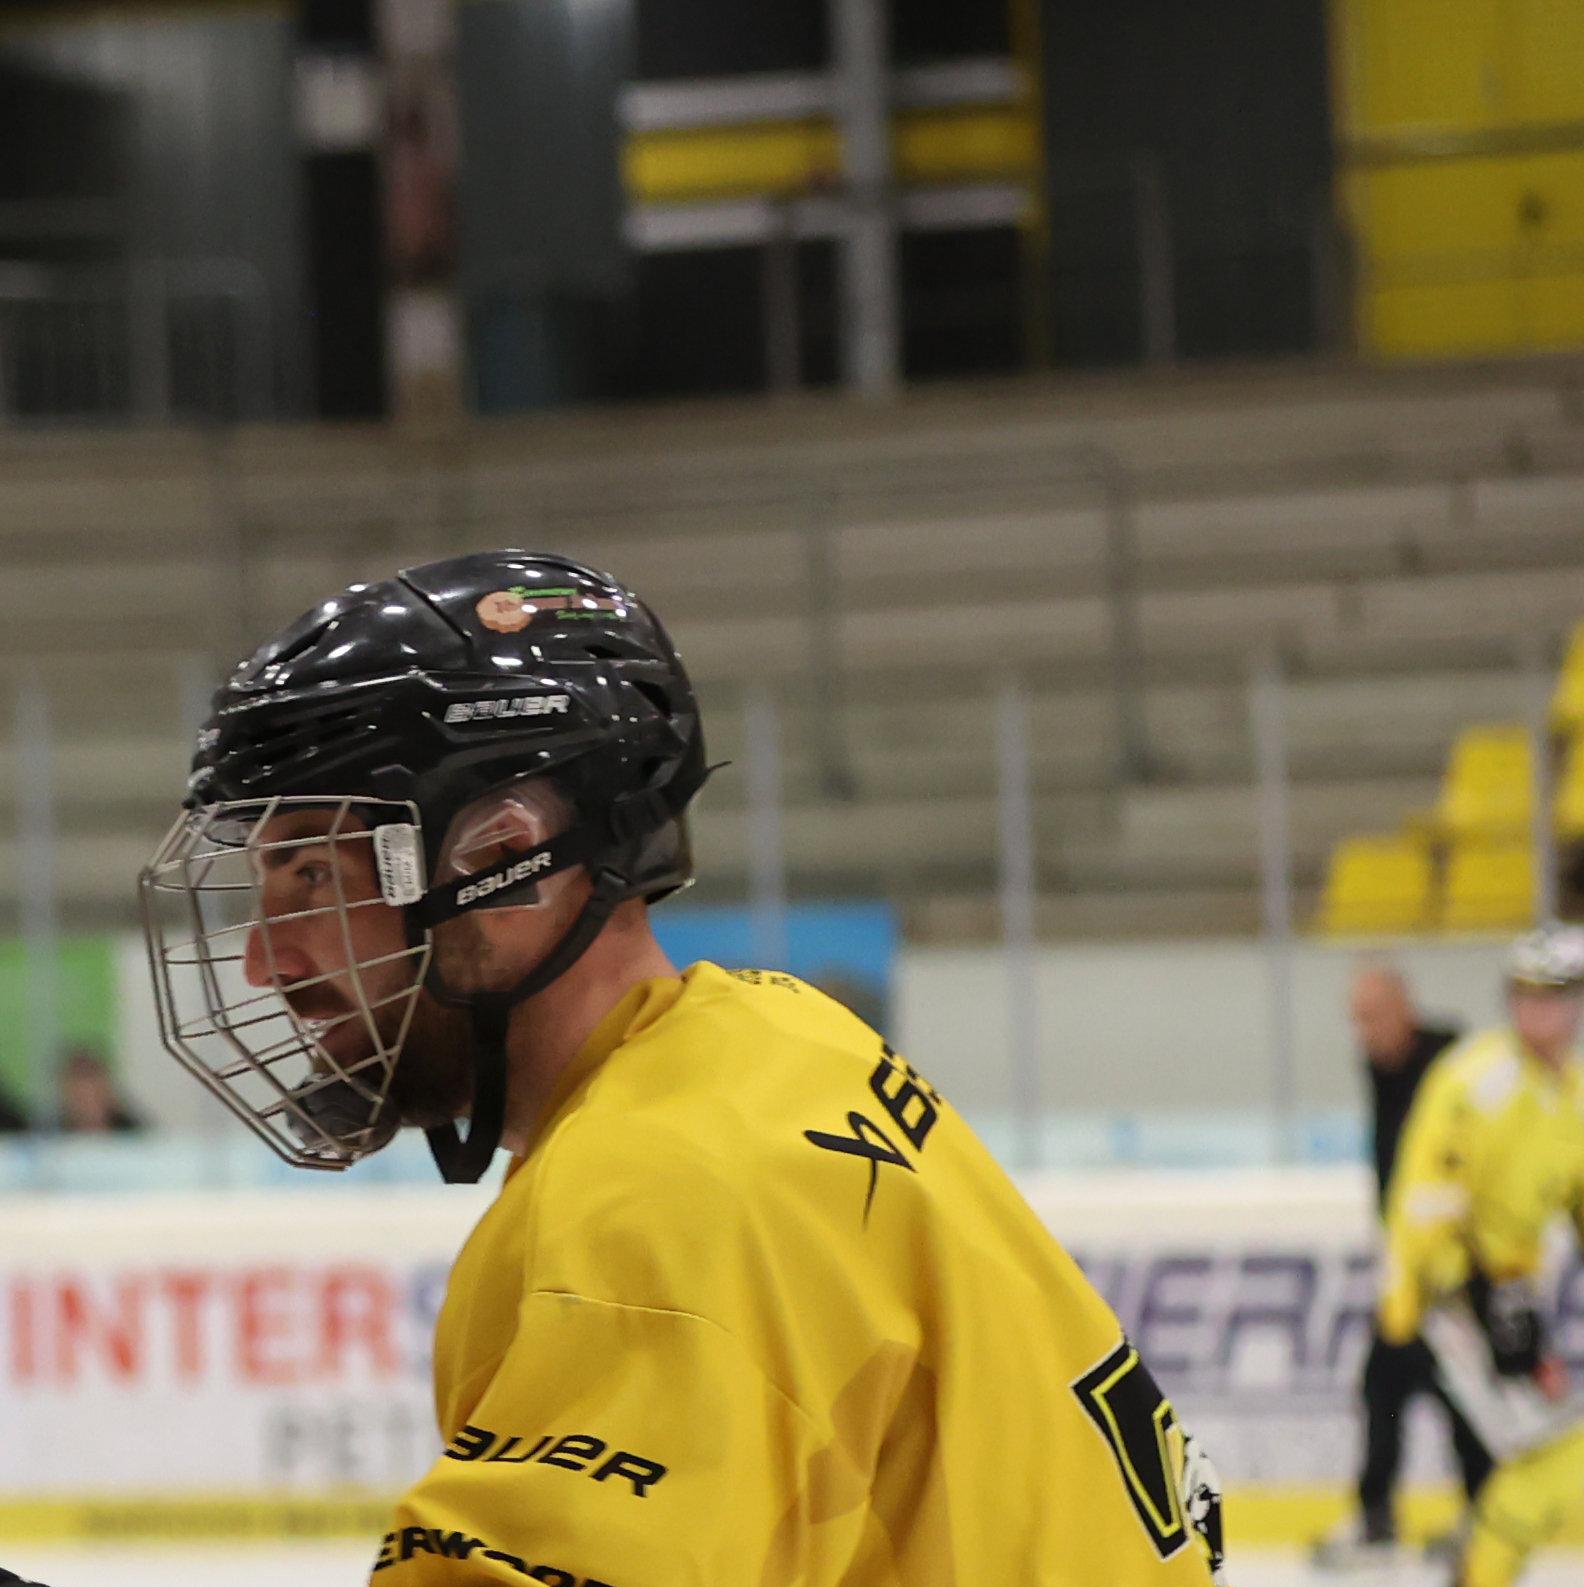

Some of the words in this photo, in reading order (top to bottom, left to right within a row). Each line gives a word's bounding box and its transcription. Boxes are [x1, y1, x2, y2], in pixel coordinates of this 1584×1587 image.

[444, 695, 571, 724] BAUER
[456, 851, 553, 905] BAUER
[262, 1404, 418, 1476] PET
[443, 1425, 670, 1498] AUER
